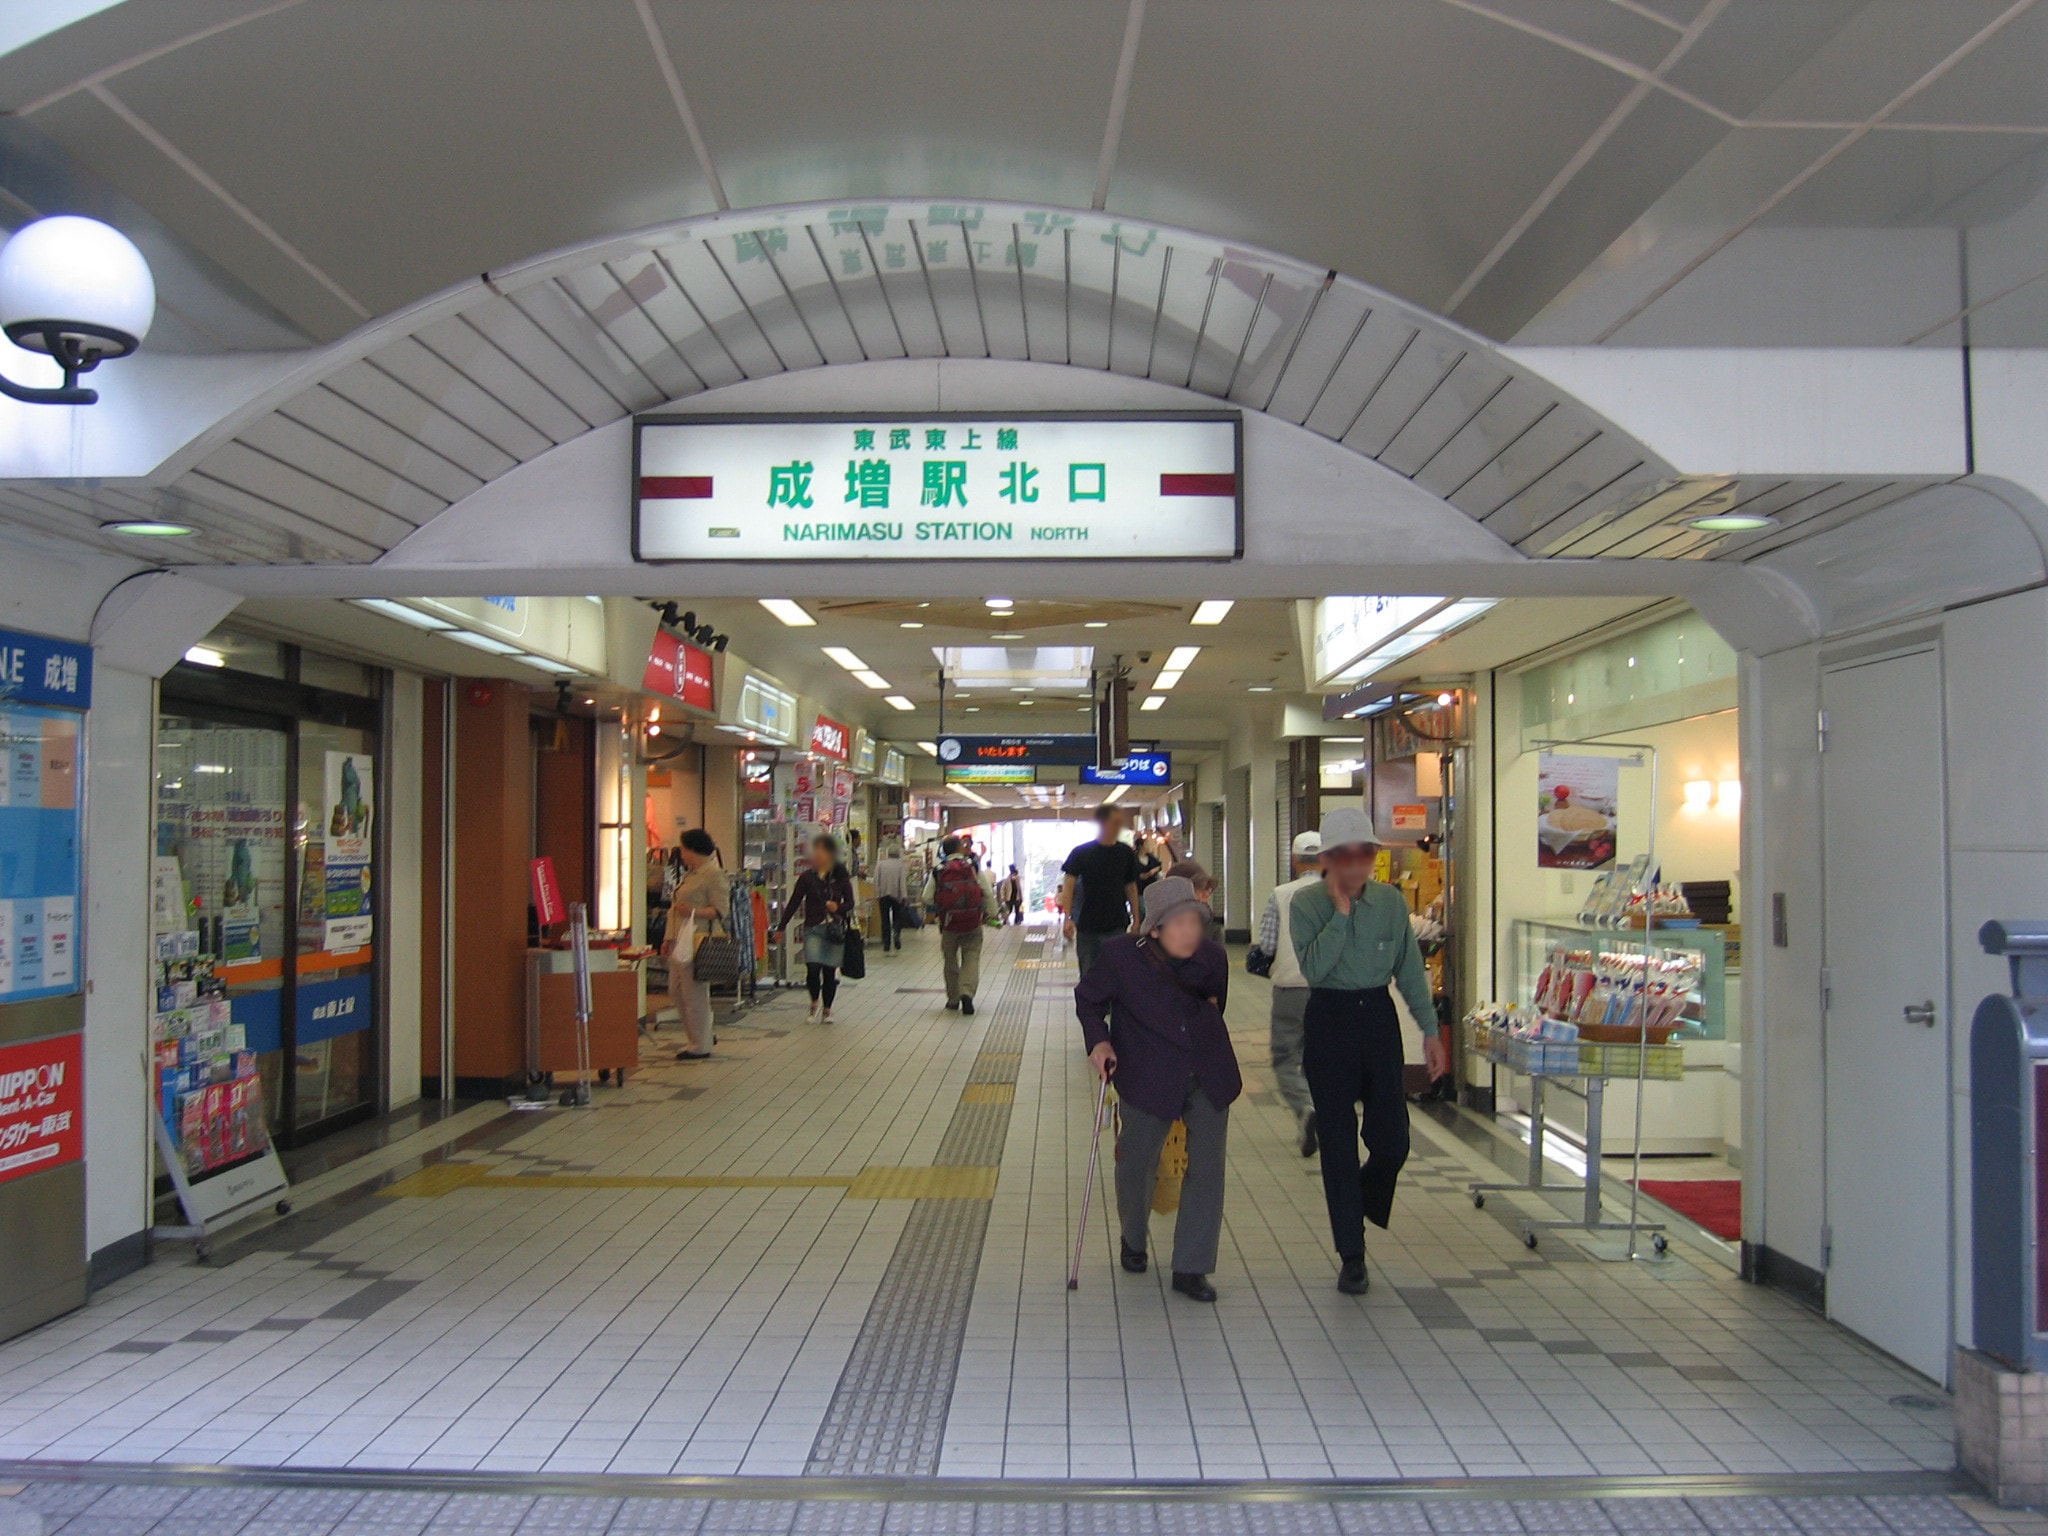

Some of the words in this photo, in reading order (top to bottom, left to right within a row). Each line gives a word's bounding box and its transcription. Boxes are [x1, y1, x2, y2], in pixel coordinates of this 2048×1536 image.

[854, 428, 1019, 451] 東武東上線
[766, 460, 1107, 508] 成増駅北口
[783, 523, 903, 541] NARIMASU
[915, 522, 1012, 541] STATION
[1030, 527, 1088, 541] NORTH
[44, 654, 78, 693] 成増
